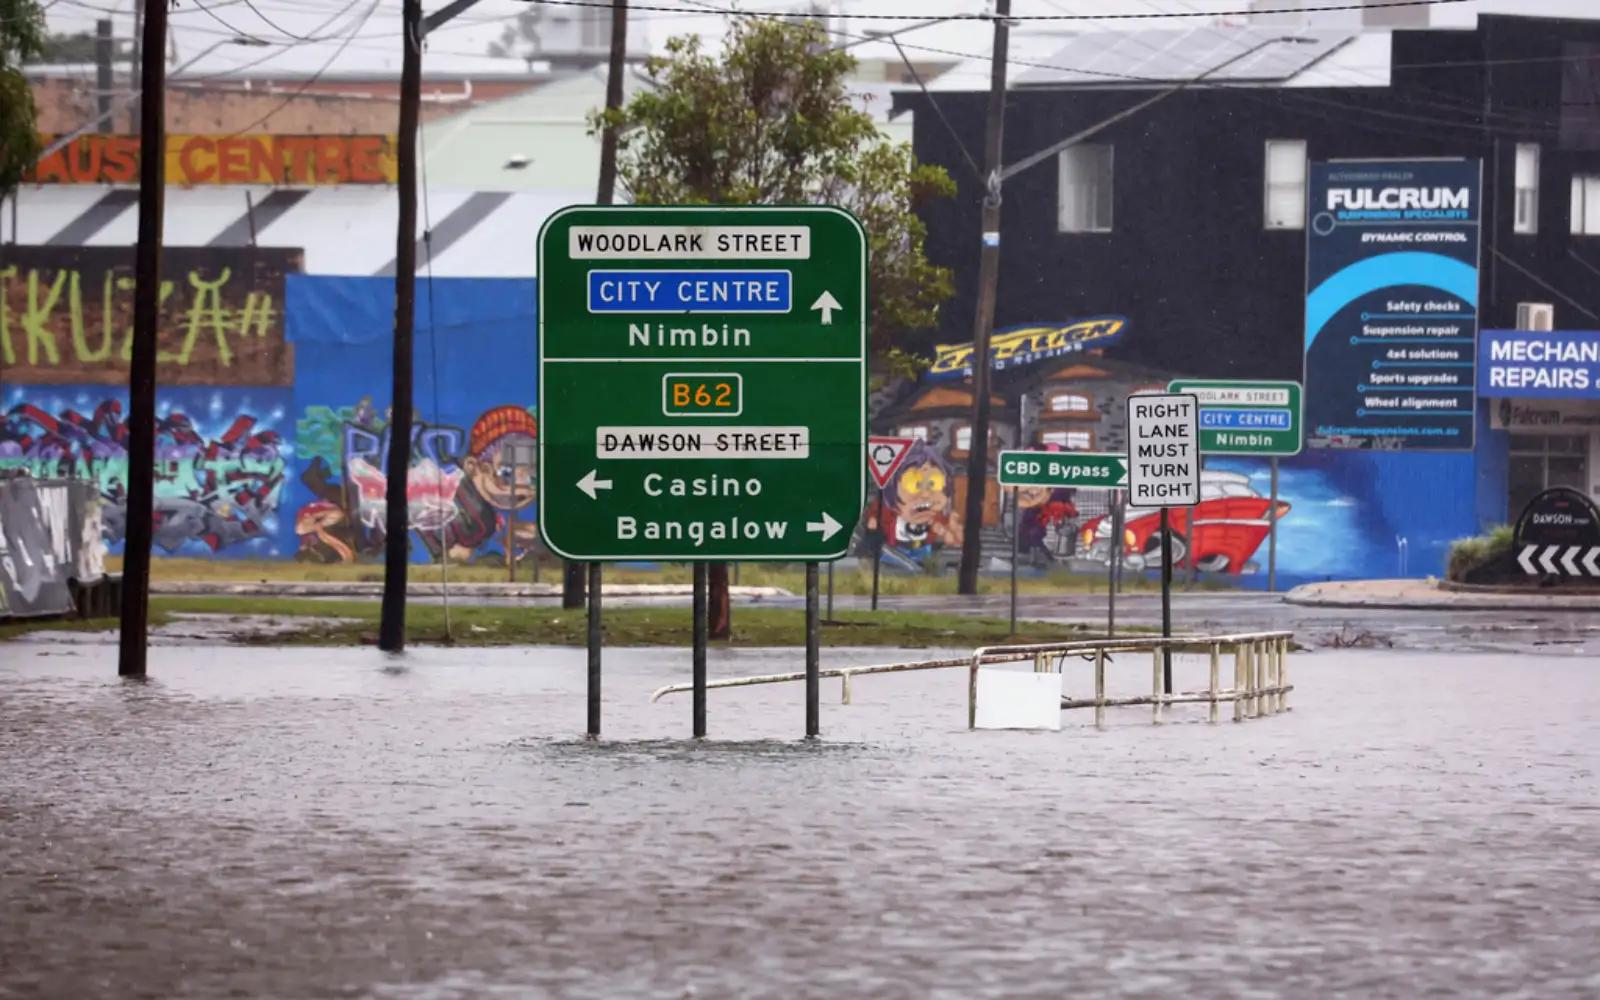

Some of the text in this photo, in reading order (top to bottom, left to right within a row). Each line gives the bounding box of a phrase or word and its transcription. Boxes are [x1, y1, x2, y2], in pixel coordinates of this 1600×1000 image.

[22, 136, 384, 184] AUS CENTRE
[1327, 188, 1469, 210] FULCRUM
[578, 234, 802, 252] WOODLARK STREET
[1361, 233, 1467, 242] DYNAMIC CONTROL
[600, 281, 780, 302] CITY CENTRE
[1387, 301, 1460, 313] Safety checks
[629, 324, 751, 346] Nimbin
[1363, 325, 1459, 337] Suspension repair
[1387, 349, 1459, 359] 4x4 solutions
[1491, 340, 1600, 362] MECHAN
[1370, 373, 1458, 385] Sports upgrades
[1490, 367, 1590, 389] REPAIRS
[673, 383, 732, 406] B62
[1196, 391, 1284, 401] ODLARK STREET
[1365, 397, 1457, 409] Wheel alignment
[1136, 404, 1190, 418] RIGHT
[1204, 413, 1285, 425] CITY CENTRE
[1139, 424, 1189, 438] LANE
[605, 434, 801, 452] DAWSON STREET
[1216, 433, 1273, 446] Nimbin
[1139, 443, 1189, 458] MUST
[1005, 461, 1110, 479] CBD Bypass
[1140, 463, 1189, 477] TURN
[643, 473, 762, 496] Casino
[1138, 483, 1192, 497] RIGHT
[1533, 513, 1572, 525] DAWSON
[617, 516, 788, 546] Bangalow
